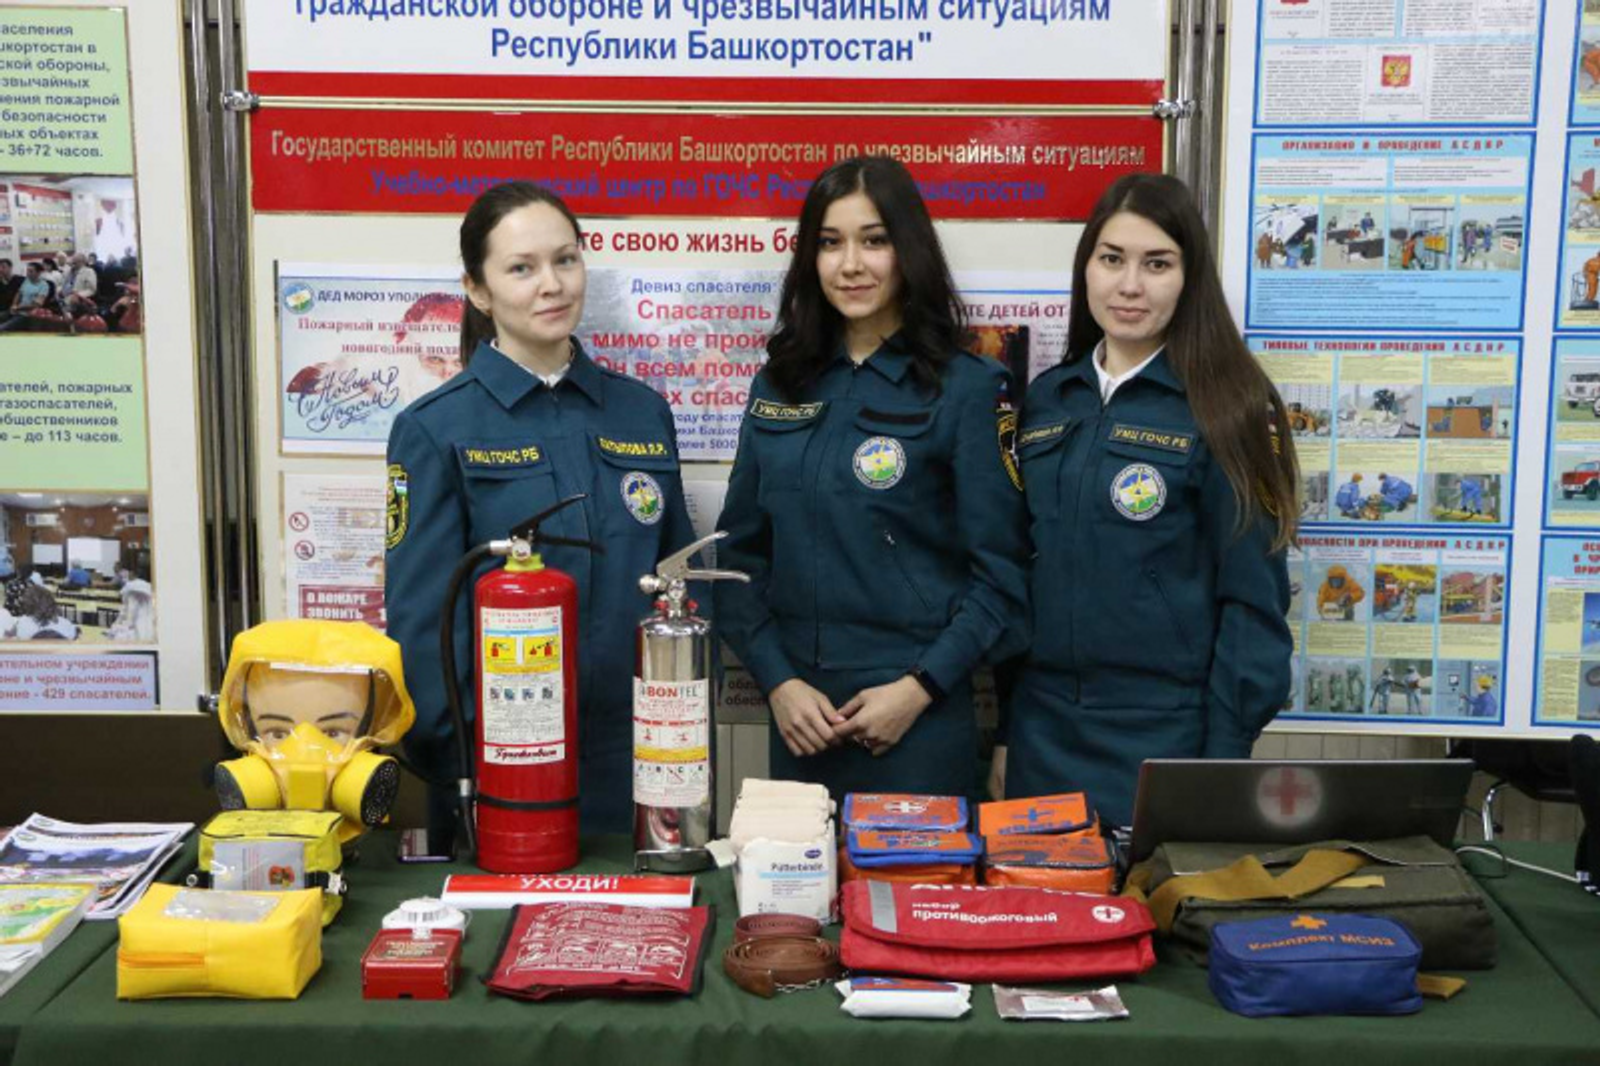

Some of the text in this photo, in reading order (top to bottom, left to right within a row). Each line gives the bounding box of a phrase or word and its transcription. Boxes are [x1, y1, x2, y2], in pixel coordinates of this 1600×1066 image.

[939, 0, 1110, 28] ситуациям
[87, 44, 97, 54] в
[491, 28, 932, 68] Республики Башкортостан"
[36, 59, 110, 73] обороны,
[45, 93, 120, 109] пожарной
[2, 110, 107, 123] безопасности
[29, 127, 99, 140] объектах
[55, 148, 104, 158] часов.
[271, 130, 456, 163] Государственный
[463, 136, 545, 160] комитет
[551, 135, 673, 167] Республики
[680, 136, 827, 164] Башкортостан
[1032, 144, 1145, 170] ситуациям
[606, 175, 665, 202] центр
[672, 178, 697, 198] по
[703, 173, 759, 198] ГОЧС
[612, 231, 680, 252] свою
[686, 232, 765, 254] жизнь
[631, 278, 682, 295] Девиз
[318, 290, 341, 302] ДЕД
[344, 290, 385, 302] МОРОЗ
[637, 299, 772, 321] Спасатель
[988, 301, 1040, 321] ДЕТЕЙ
[1044, 303, 1067, 318] ОТ
[298, 317, 373, 333] Пожарный
[591, 333, 660, 348] мимо
[668, 333, 697, 348] не
[635, 361, 695, 378] всем
[57, 383, 134, 395] пожарных
[24, 431, 44, 444] до
[48, 429, 72, 442] 113
[75, 433, 123, 443] часов.
[1114, 426, 1138, 442] УМЦ
[522, 446, 540, 462] РБ
[520, 876, 619, 891] УХОДИ!
[912, 908, 1058, 924] противоожоговый
[1248, 933, 1396, 952] Комплект МСИЗ
